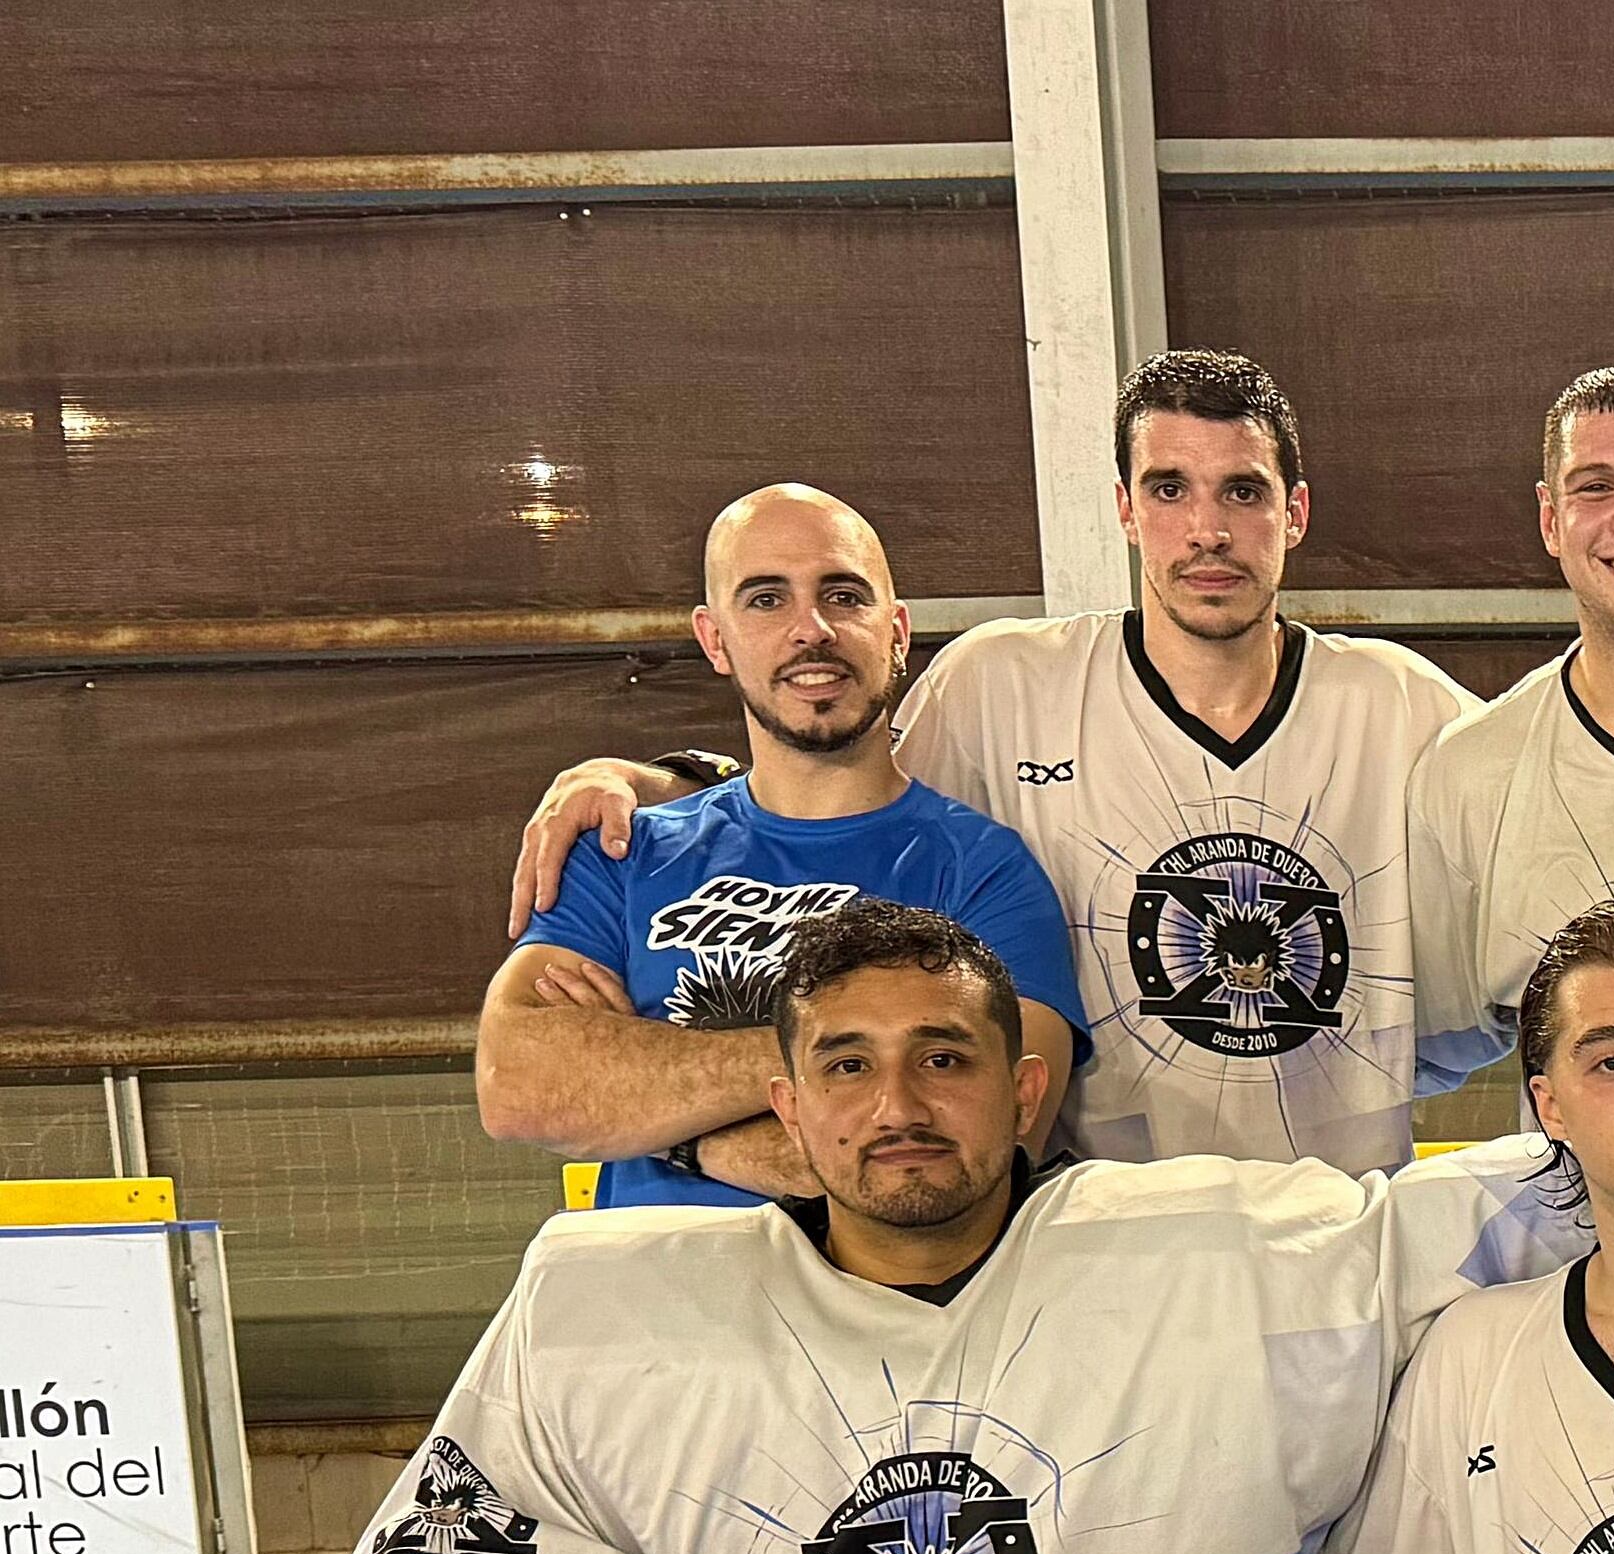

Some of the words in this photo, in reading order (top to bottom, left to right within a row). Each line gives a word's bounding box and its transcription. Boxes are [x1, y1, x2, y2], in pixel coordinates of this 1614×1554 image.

[1160, 853, 1190, 874] CHL
[1188, 839, 1248, 866] ARANDA
[1251, 842, 1271, 864] DE
[1273, 849, 1319, 889] DUERO
[699, 880, 788, 915] HOY
[788, 888, 850, 915] ME
[655, 905, 794, 952] SIEN
[1212, 1029, 1246, 1051] DESDE
[1247, 1031, 1278, 1051] 2010
[66, 1445, 164, 1498] del
[854, 1460, 932, 1509] ARANDA
[938, 1460, 966, 1486] DE
